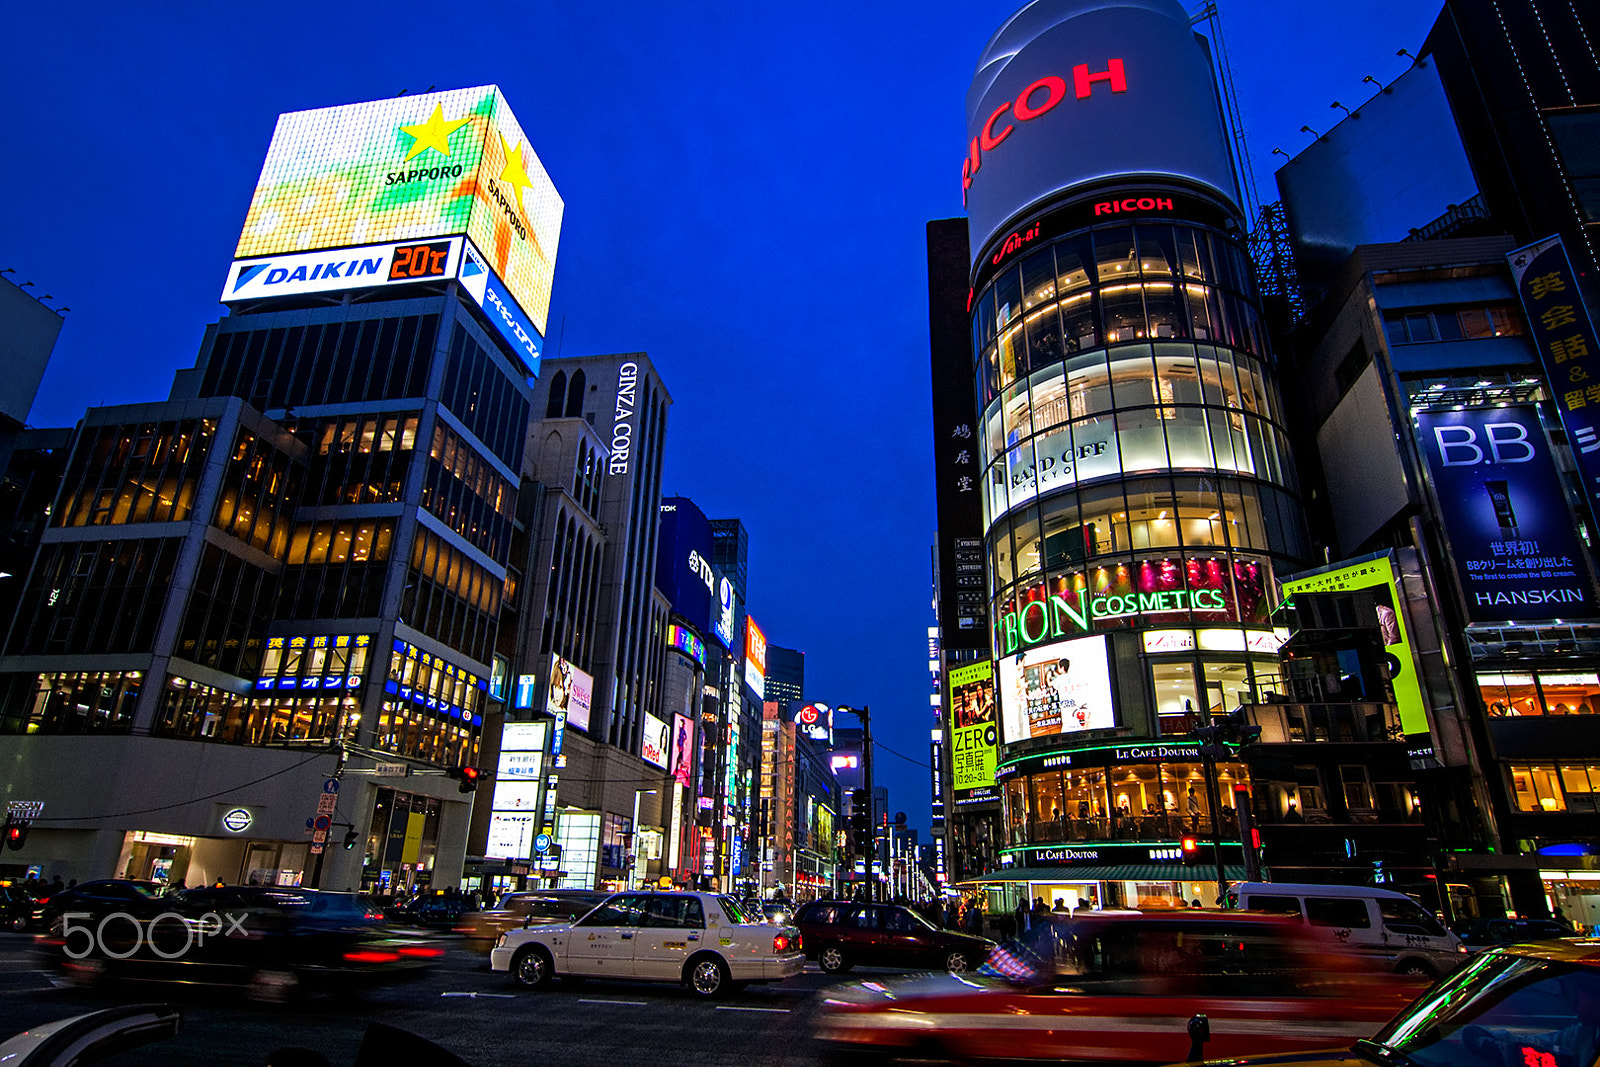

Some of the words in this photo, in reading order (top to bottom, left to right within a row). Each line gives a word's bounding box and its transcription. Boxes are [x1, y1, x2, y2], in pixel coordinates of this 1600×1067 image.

[962, 57, 1128, 210] RICOH
[385, 163, 463, 186] SAPPORO
[487, 178, 527, 242] SAPPORO
[1094, 197, 1174, 216] RICOH
[263, 257, 383, 285] DAIKIN
[614, 361, 638, 422] GINZA
[609, 422, 632, 476] CORE
[1433, 422, 1536, 467] B.B
[1022, 466, 1072, 492] TOKYO
[1507, 572, 1528, 580] create
[1528, 571, 1540, 579] the
[1090, 589, 1226, 617] COSMETICS
[1475, 588, 1584, 605] HANSKIN
[268, 635, 370, 649] 英会話留学
[258, 676, 342, 689] イーオン
[401, 687, 450, 711] イーオン
[641, 740, 660, 763] InRed
[955, 725, 997, 752] ZERO
[955, 750, 985, 774] 写真展
[784, 744, 795, 863] MATSUZAKAYA
[733, 840, 742, 868] FANCL
